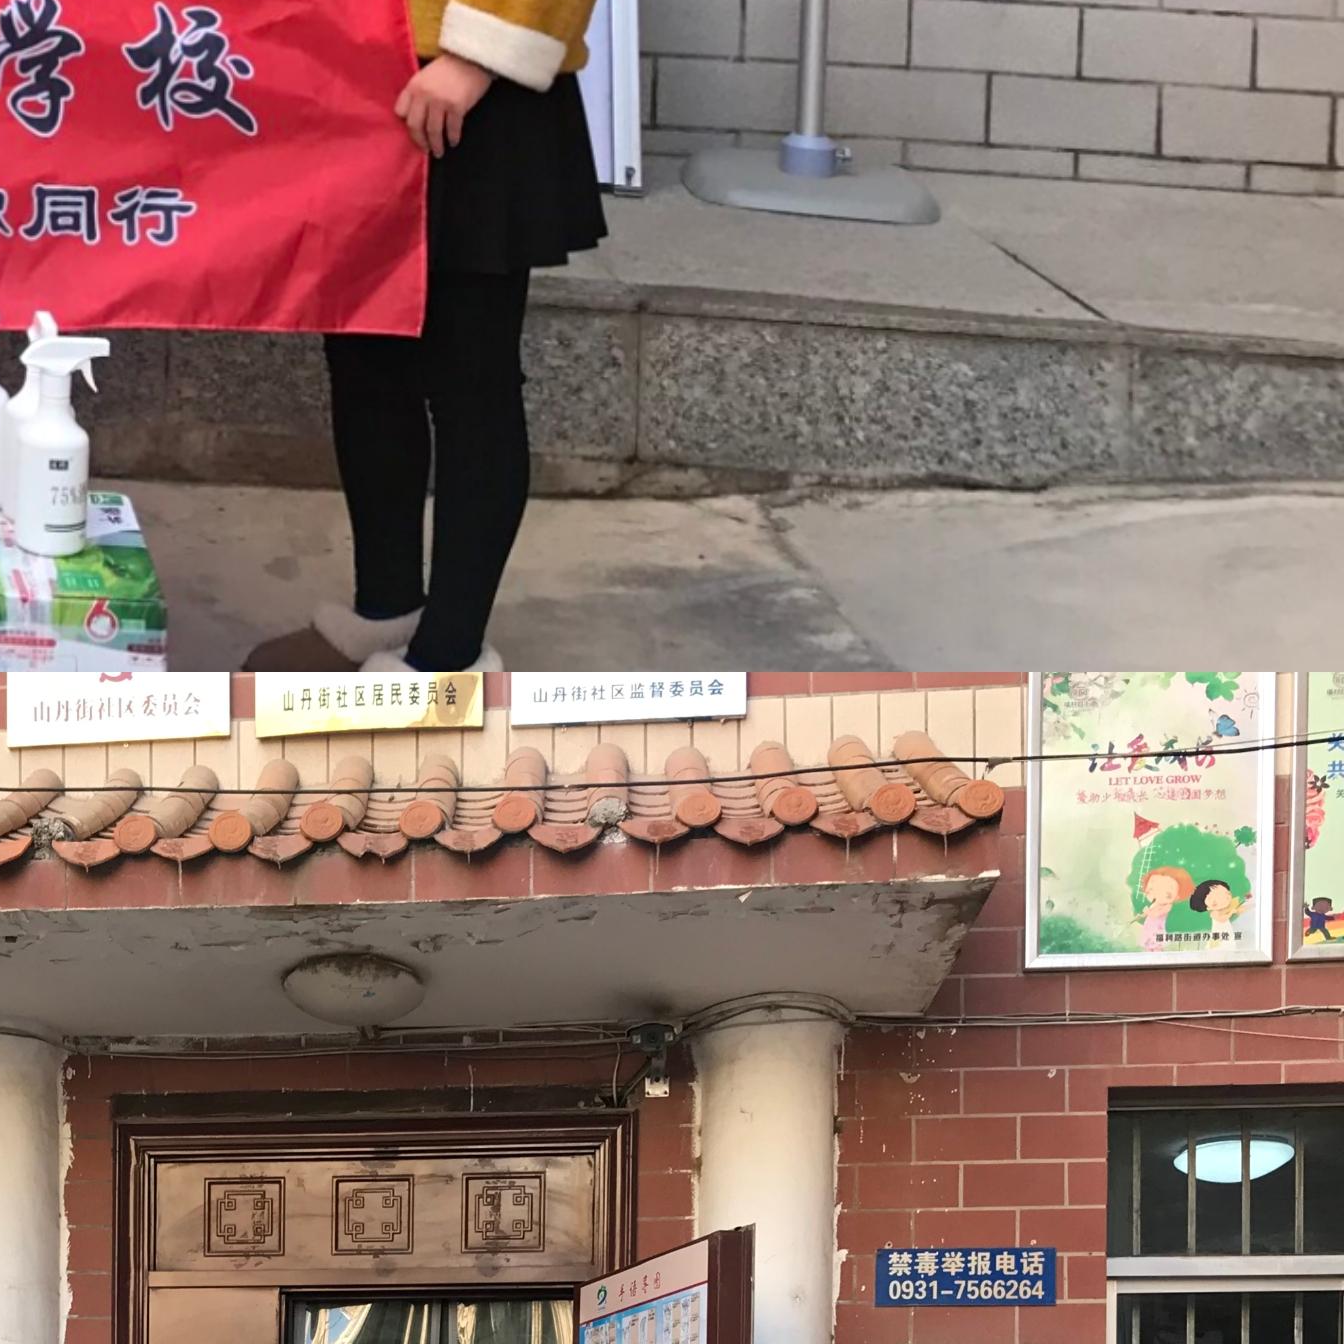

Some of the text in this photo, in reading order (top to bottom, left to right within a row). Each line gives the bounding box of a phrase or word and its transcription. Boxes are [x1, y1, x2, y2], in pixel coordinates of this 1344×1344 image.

[282, 679, 458, 712] 山丹街社区居民委员会
[531, 678, 726, 706] 山丹街社区监督委员会
[1108, 774, 1202, 786] LET LOVE GROW
[888, 1251, 1046, 1277] 禁毒举报电话
[888, 1279, 1045, 1301] 0931-7566264
